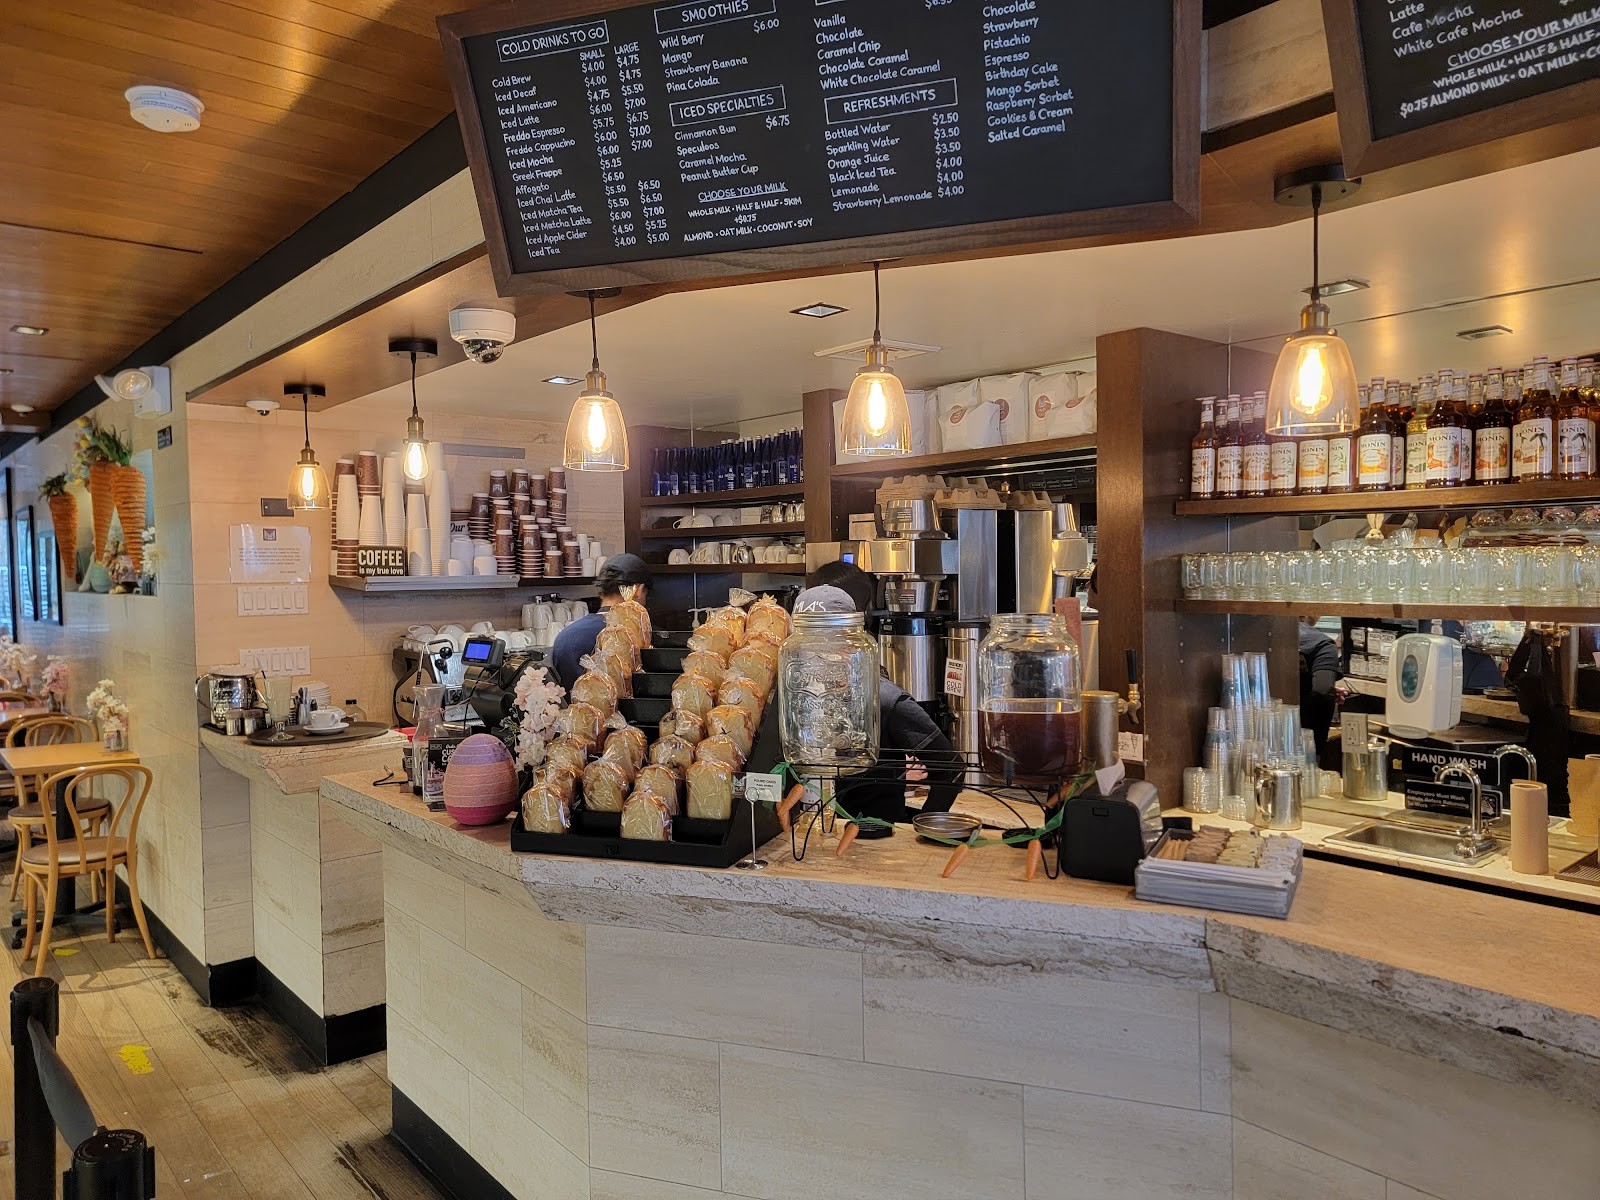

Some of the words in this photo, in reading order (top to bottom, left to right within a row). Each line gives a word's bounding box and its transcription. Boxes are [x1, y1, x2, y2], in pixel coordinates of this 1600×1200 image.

[682, 1, 749, 23] SMOOTHIES
[983, 0, 1036, 17] Chocolate
[1389, 1, 1425, 23] Latte
[814, 14, 846, 28] Vanilla
[983, 17, 1039, 34] Strawberry
[1392, 21, 1422, 40] Cafe
[1426, 4, 1474, 29] Mocha
[502, 41, 530, 55] COLD
[532, 33, 569, 50] DRINKS
[570, 30, 586, 43] TO
[588, 27, 604, 39] GO
[659, 35, 679, 49] Wild
[681, 34, 704, 46] Berry
[753, 19, 779, 34] $6.00
[816, 27, 864, 44] Chocolate
[983, 34, 1030, 51] Pistachio
[1393, 39, 1434, 58] White
[1437, 24, 1468, 44] Cafe
[1473, 8, 1524, 33] Mocha
[579, 49, 605, 61] SMALL
[614, 42, 639, 55] LARGE
[817, 42, 856, 60] Caramel
[858, 41, 881, 52] Chip
[1447, 36, 1511, 68] CHOOSE
[1512, 21, 1561, 45] YOUR
[662, 51, 692, 64] Mango
[664, 63, 711, 78] Strawberry
[713, 56, 748, 70] Banana
[819, 57, 865, 75] Chocolate
[868, 49, 909, 67] Caramel
[984, 51, 1030, 66] Espresso
[1433, 70, 1477, 89] WHOLE
[1477, 58, 1507, 76] MILK
[1514, 44, 1546, 64] HALF
[1560, 29, 1595, 50] HALF
[492, 77, 510, 89] Cold
[512, 75, 531, 85] Brew
[617, 54, 639, 69] $4.75
[820, 77, 848, 90] White
[850, 67, 898, 85] Chocolate
[900, 60, 941, 77] Caramel
[985, 67, 1030, 82] Birthday
[1031, 62, 1058, 75] Cake
[1430, 82, 1479, 107] ALMOND
[1480, 73, 1510, 92] MILK
[1518, 62, 1544, 79] OAT
[1547, 52, 1579, 71] MILK
[513, 86, 537, 99] Decaf
[666, 83, 687, 93] Pina
[688, 76, 720, 89] Colada
[986, 84, 1022, 98] Mango
[1024, 75, 1060, 93] Sorbet
[498, 104, 514, 116] Iced
[517, 100, 557, 114] Americano
[587, 89, 610, 102] $4.75
[679, 105, 705, 119] ICED
[707, 94, 774, 115] SPECIALTIES
[843, 89, 936, 113] REFRESHMENTS
[986, 97, 1036, 112] Raspberry
[1039, 89, 1074, 105] Sorbet
[518, 115, 540, 126] Latte
[589, 103, 612, 116] $6.00
[987, 112, 1027, 126] Cookies
[1038, 107, 1073, 120] Cream
[503, 133, 530, 143] Freddo
[532, 126, 566, 140] Espresso
[627, 111, 649, 125] $6.75
[674, 128, 718, 141] Cinnamon
[719, 125, 737, 135] Bun
[766, 115, 790, 130] $6.75
[824, 126, 859, 141] Bottled
[860, 122, 891, 135] Water
[988, 127, 1020, 143] Salted
[1022, 120, 1066, 136] Caramel
[506, 146, 533, 157] Freddo
[535, 138, 575, 152] Cappucino
[629, 125, 651, 138] $7.00
[677, 141, 720, 156] Speculoos
[826, 140, 869, 156] Sparkling
[871, 136, 901, 148] Water
[934, 127, 960, 141] $3.50
[509, 159, 526, 170] Iced
[527, 155, 554, 168] Mocha
[679, 155, 714, 169] Caramel
[716, 153, 747, 164] Mocha
[828, 157, 862, 169] Orange
[864, 152, 890, 164] Juice
[829, 171, 855, 183] Black
[857, 167, 876, 180] Iced
[877, 167, 897, 176] Tea
[935, 156, 962, 170] $4.00
[512, 171, 535, 182] Greek
[536, 167, 563, 180] Frappe
[681, 170, 711, 182] Peanut
[712, 166, 740, 178] Butter
[741, 165, 759, 176] Cup
[831, 182, 880, 198] Lemonade
[937, 171, 964, 184] $4.00
[515, 183, 550, 196] Affogato
[536, 192, 554, 204] Chai
[555, 189, 576, 202] Latte
[605, 185, 626, 196] $5.50
[698, 188, 736, 201] CHOOSE
[737, 184, 763, 196] YOUR
[765, 182, 786, 192] MILK
[520, 211, 537, 222] Iced
[539, 206, 567, 219] Matcha
[568, 204, 583, 214] Tea
[640, 193, 663, 204] $6.50
[688, 207, 713, 218] WHOLE
[736, 203, 753, 212] HALF
[754, 201, 760, 210] &
[761, 199, 779, 209] HALF
[784, 196, 802, 206] SKIM
[833, 196, 881, 212] Strawberry
[883, 190, 933, 204] Lemonade
[541, 219, 570, 231] Matcha
[570, 217, 592, 227] Latte
[643, 206, 664, 218] $7.00
[526, 236, 542, 246] Iced
[543, 230, 565, 244] Apple
[566, 230, 588, 241] Cider
[684, 230, 714, 242] ALMOND
[719, 228, 734, 237] OAT
[736, 225, 752, 235] MILK
[757, 220, 793, 233] COCONUT
[797, 218, 813, 228] SOY
[545, 247, 561, 256] Tea
[614, 236, 637, 248] $4.00
[358, 550, 403, 566] COFFEE
[1412, 752, 1446, 765] HAND
[1449, 756, 1487, 769] WASH
